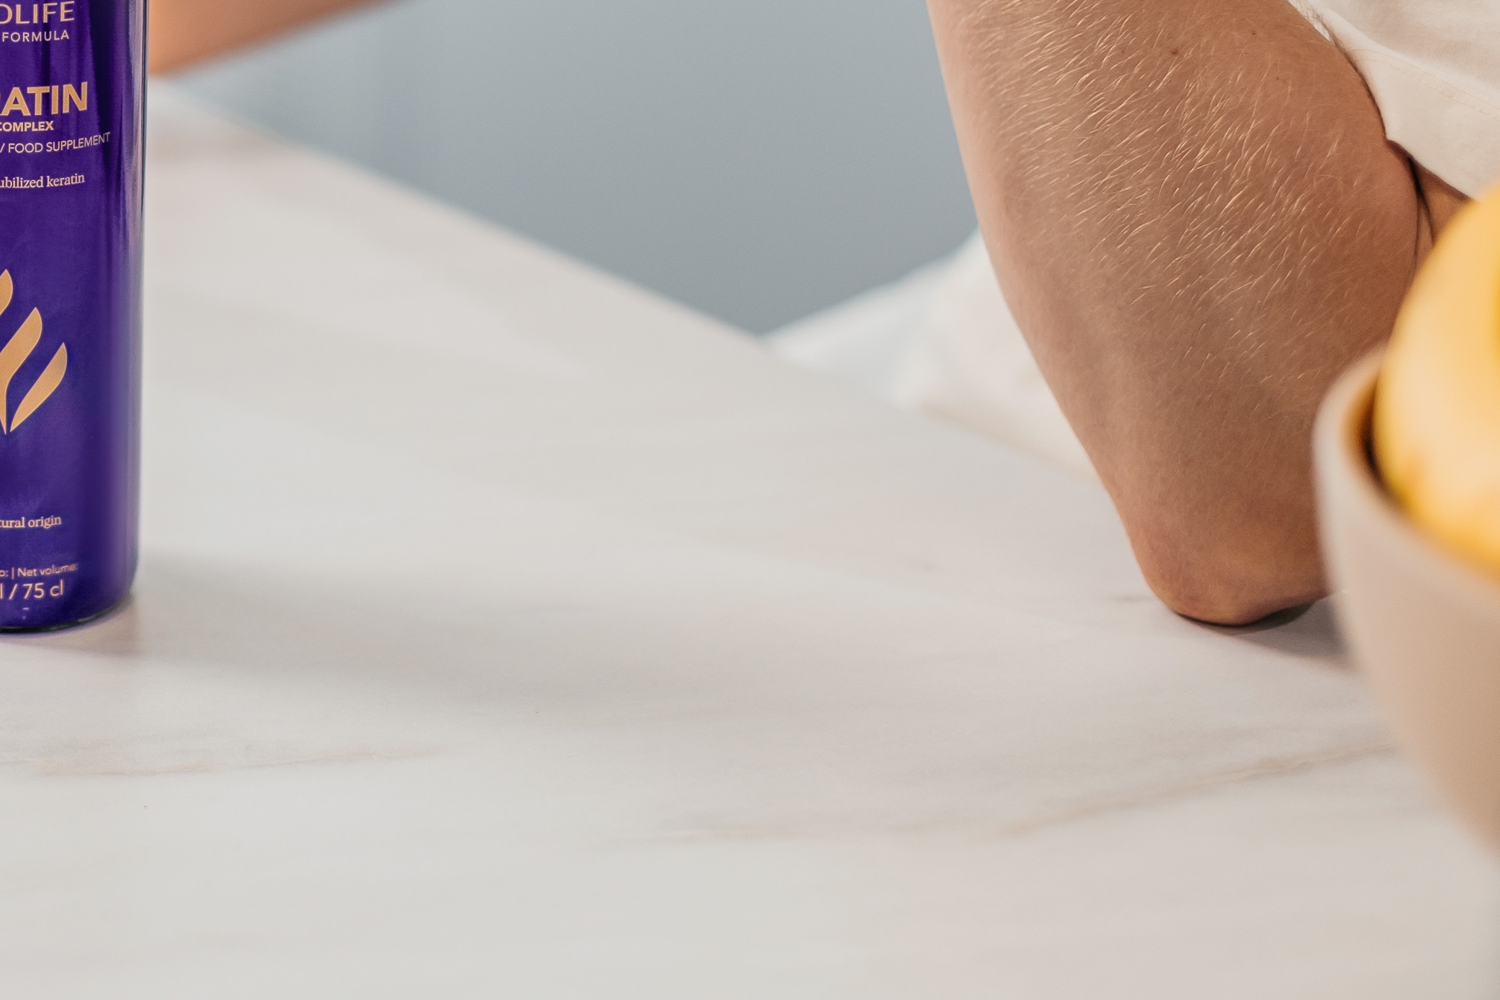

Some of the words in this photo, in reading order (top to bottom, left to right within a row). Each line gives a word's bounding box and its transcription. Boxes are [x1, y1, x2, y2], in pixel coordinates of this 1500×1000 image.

[1, 29, 70, 43] FORMULA
[7, 142, 44, 154] FOOD
[45, 131, 111, 153] SUPPLEMENT
[46, 172, 86, 188] keratin
[27, 515, 63, 530] origin
[17, 567, 38, 577] Net
[8, 583, 19, 600] /
[22, 582, 45, 599] 75
[49, 578, 64, 598] cl
